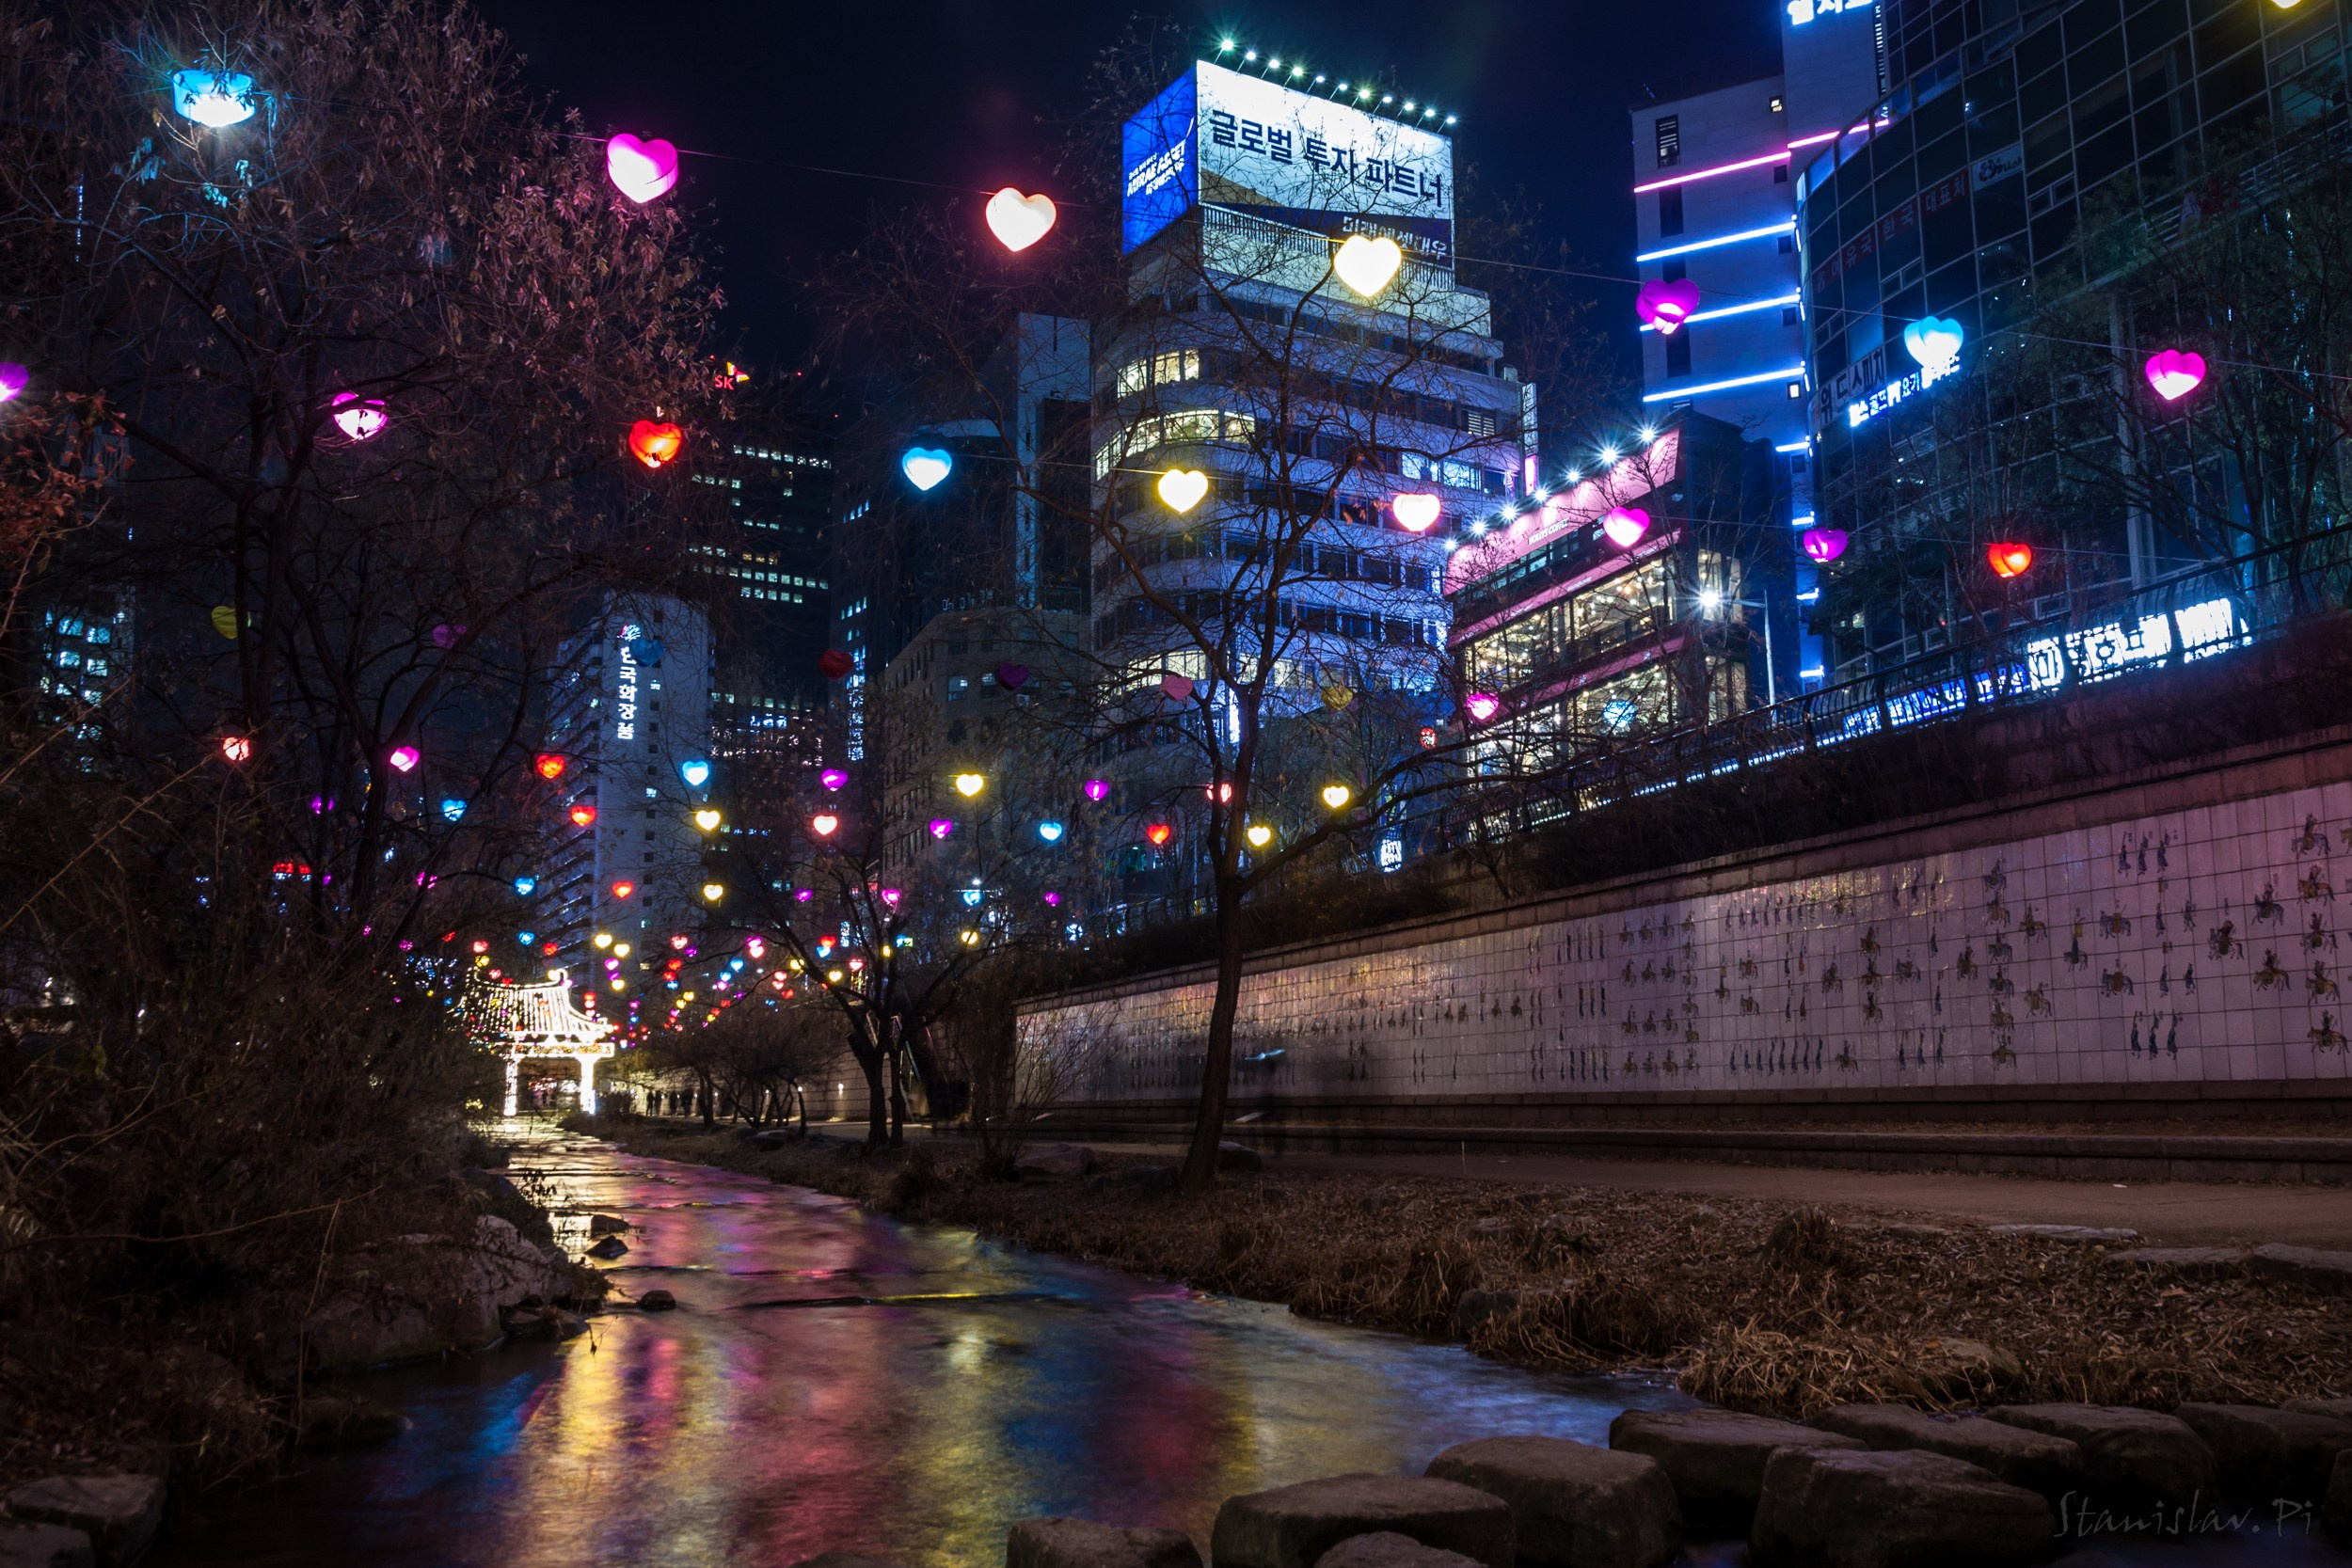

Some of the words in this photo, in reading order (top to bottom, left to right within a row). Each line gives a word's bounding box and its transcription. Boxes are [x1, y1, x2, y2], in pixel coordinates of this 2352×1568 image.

[1209, 109, 1293, 165] 글로벌
[1305, 136, 1358, 184] 투자
[1366, 153, 1442, 208] 파트너
[714, 374, 735, 390] SK
